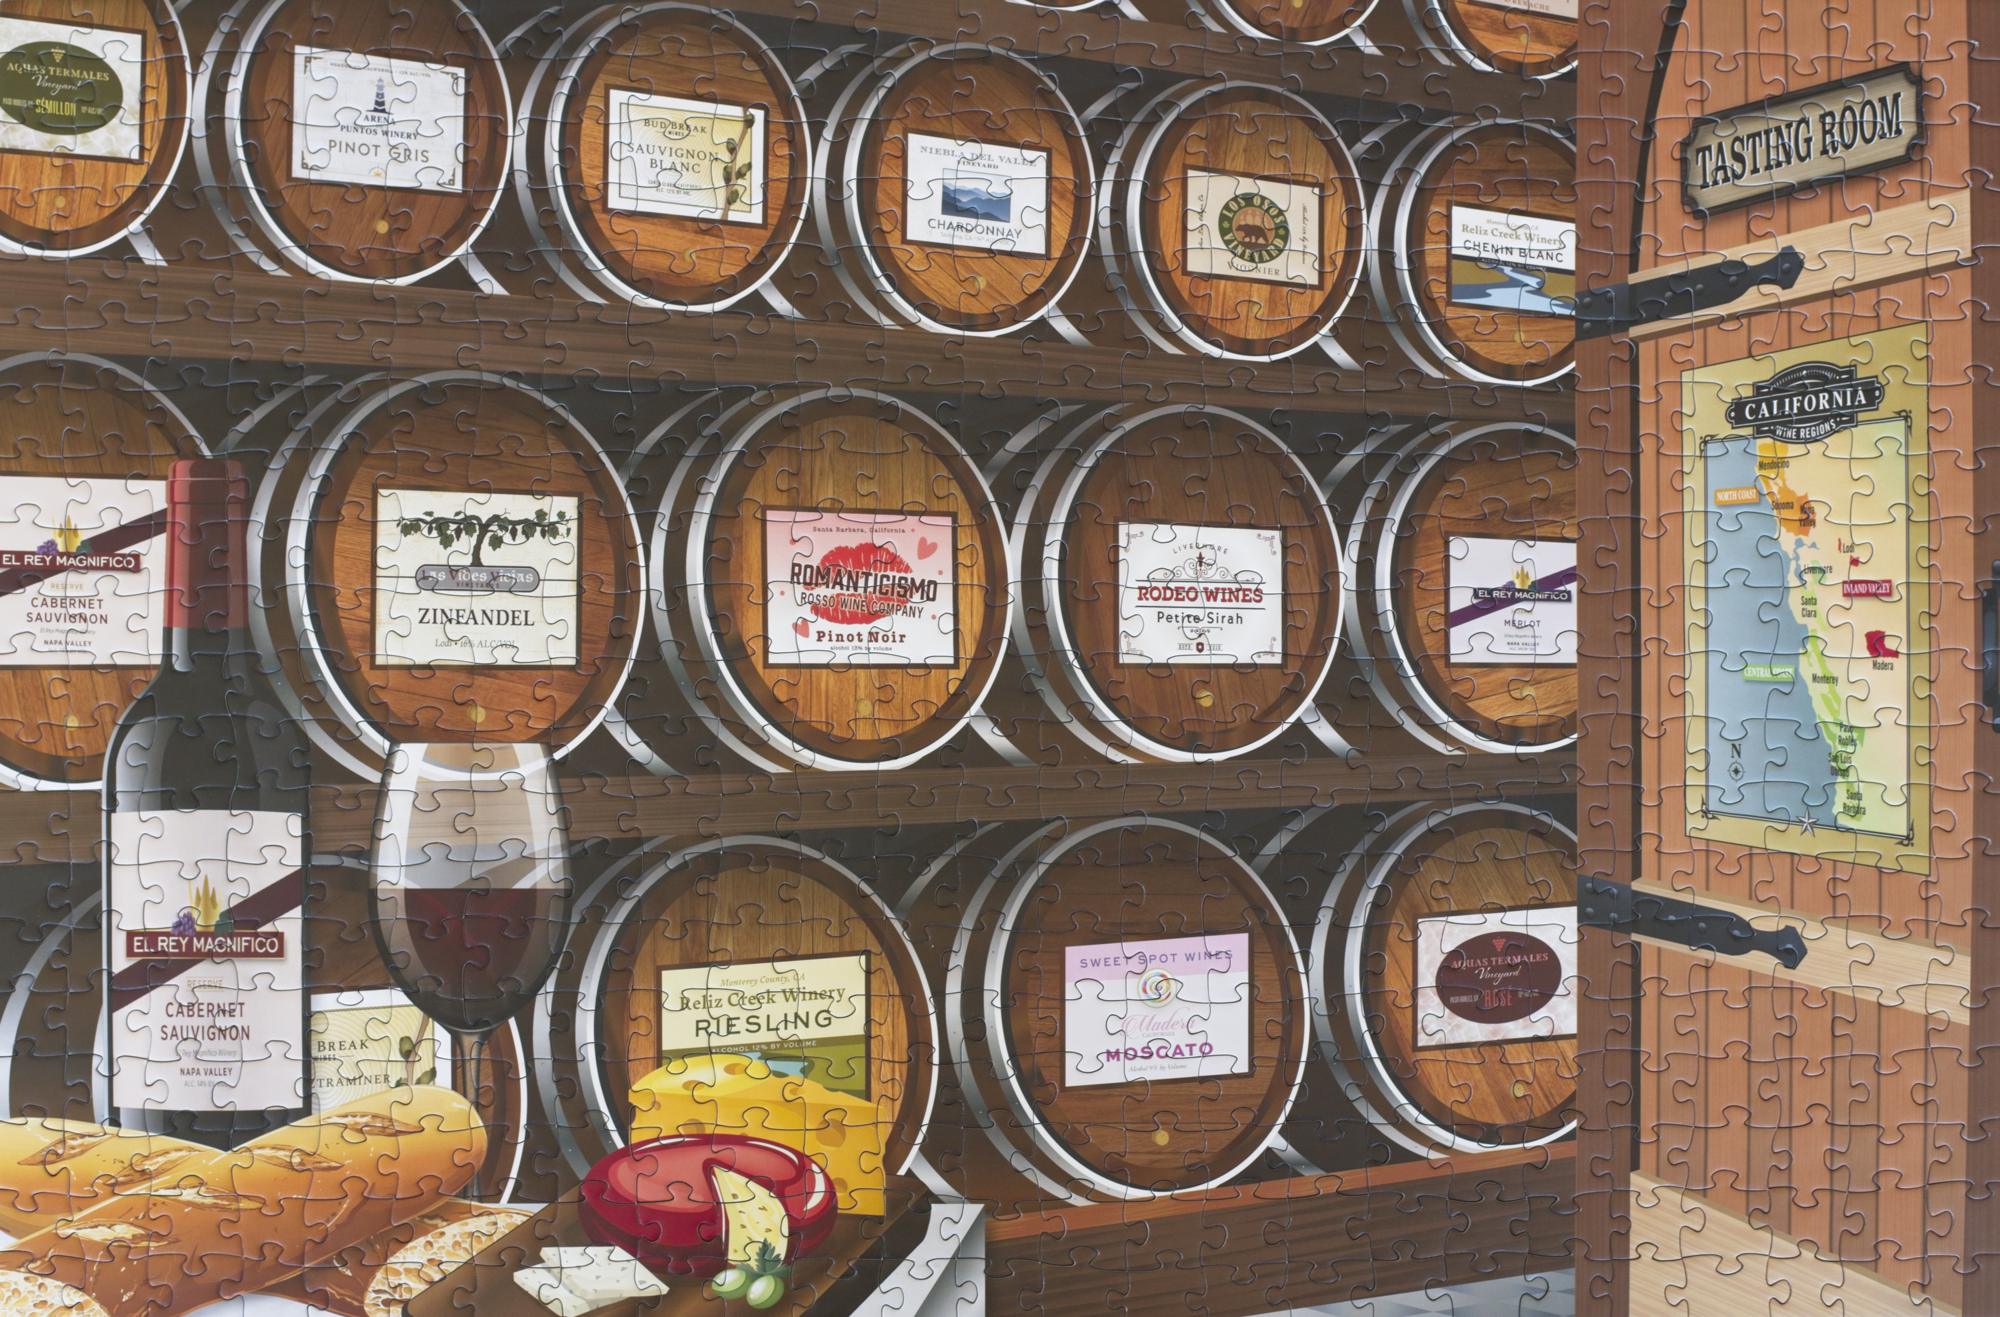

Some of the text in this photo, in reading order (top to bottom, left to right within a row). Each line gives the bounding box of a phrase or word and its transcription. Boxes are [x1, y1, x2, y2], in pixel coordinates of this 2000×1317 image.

[7, 62, 110, 82] AQUAS TERMALES
[32, 74, 82, 96] Vineyard
[363, 114, 396, 125] ARENA
[643, 118, 707, 134] BUD BREAK
[340, 124, 419, 141] PUNTOS WINERY
[1696, 92, 1905, 190] TASTING ROOM
[329, 139, 430, 163] PINOT GRIS
[627, 143, 720, 162] SAUVIGNON
[971, 152, 995, 162] DEL
[650, 158, 701, 174] BLANC
[1222, 195, 1285, 224] LOS OSOS
[928, 218, 1022, 239] CHARDONNAY
[1461, 224, 1488, 235] Reliz
[1491, 227, 1521, 240] Creek
[1222, 232, 1285, 263] VINEYARD
[1464, 240, 1564, 263] CHENIN BLANC
[1744, 386, 1868, 421] CALIFORNIA
[1775, 418, 1838, 440] WINE REGIONS
[1771, 500, 1794, 511] Sonoma
[869, 527, 907, 535] California
[3, 554, 135, 569] EL REY MAGNIFICO
[790, 562, 939, 602] ROMANTICISMO
[1843, 582, 1868, 594] INLAND
[1137, 585, 1264, 603] RODEO WINES
[1478, 590, 1568, 600] EL REY MAGNIFICO
[1801, 595, 1817, 606] Santa
[31, 597, 104, 609] CABERNET
[800, 591, 925, 619] ROSSO WINE COMPANY
[26, 612, 108, 624] SAUVIGNON
[418, 608, 536, 627] ZINFANDEL
[1157, 611, 1243, 625] Petite Sirah
[1801, 607, 1817, 618] Clara
[1504, 619, 1541, 628] MERLOT
[816, 630, 907, 644] Pinot Noir
[1872, 659, 1894, 670] Madera
[1811, 673, 1839, 686] Monterey
[1731, 744, 1742, 759] N
[133, 936, 279, 953] EL REY MAGNIFICO
[1080, 950, 1233, 968] SWEET SPOT WINES
[1490, 953, 1549, 966] TERMALES
[720, 977, 758, 987] Monterey
[1474, 966, 1521, 986] Vineyard
[680, 987, 846, 1011] Reliz Creek Winery
[165, 1002, 245, 1018] CABERNET
[695, 1010, 832, 1037] RIESLING
[160, 1025, 250, 1041] SAUVIGNON
[317, 1039, 369, 1052] BREAK
[1106, 1042, 1213, 1062] MOSCATO
[180, 1067, 233, 1076] NAPA VALLEY
